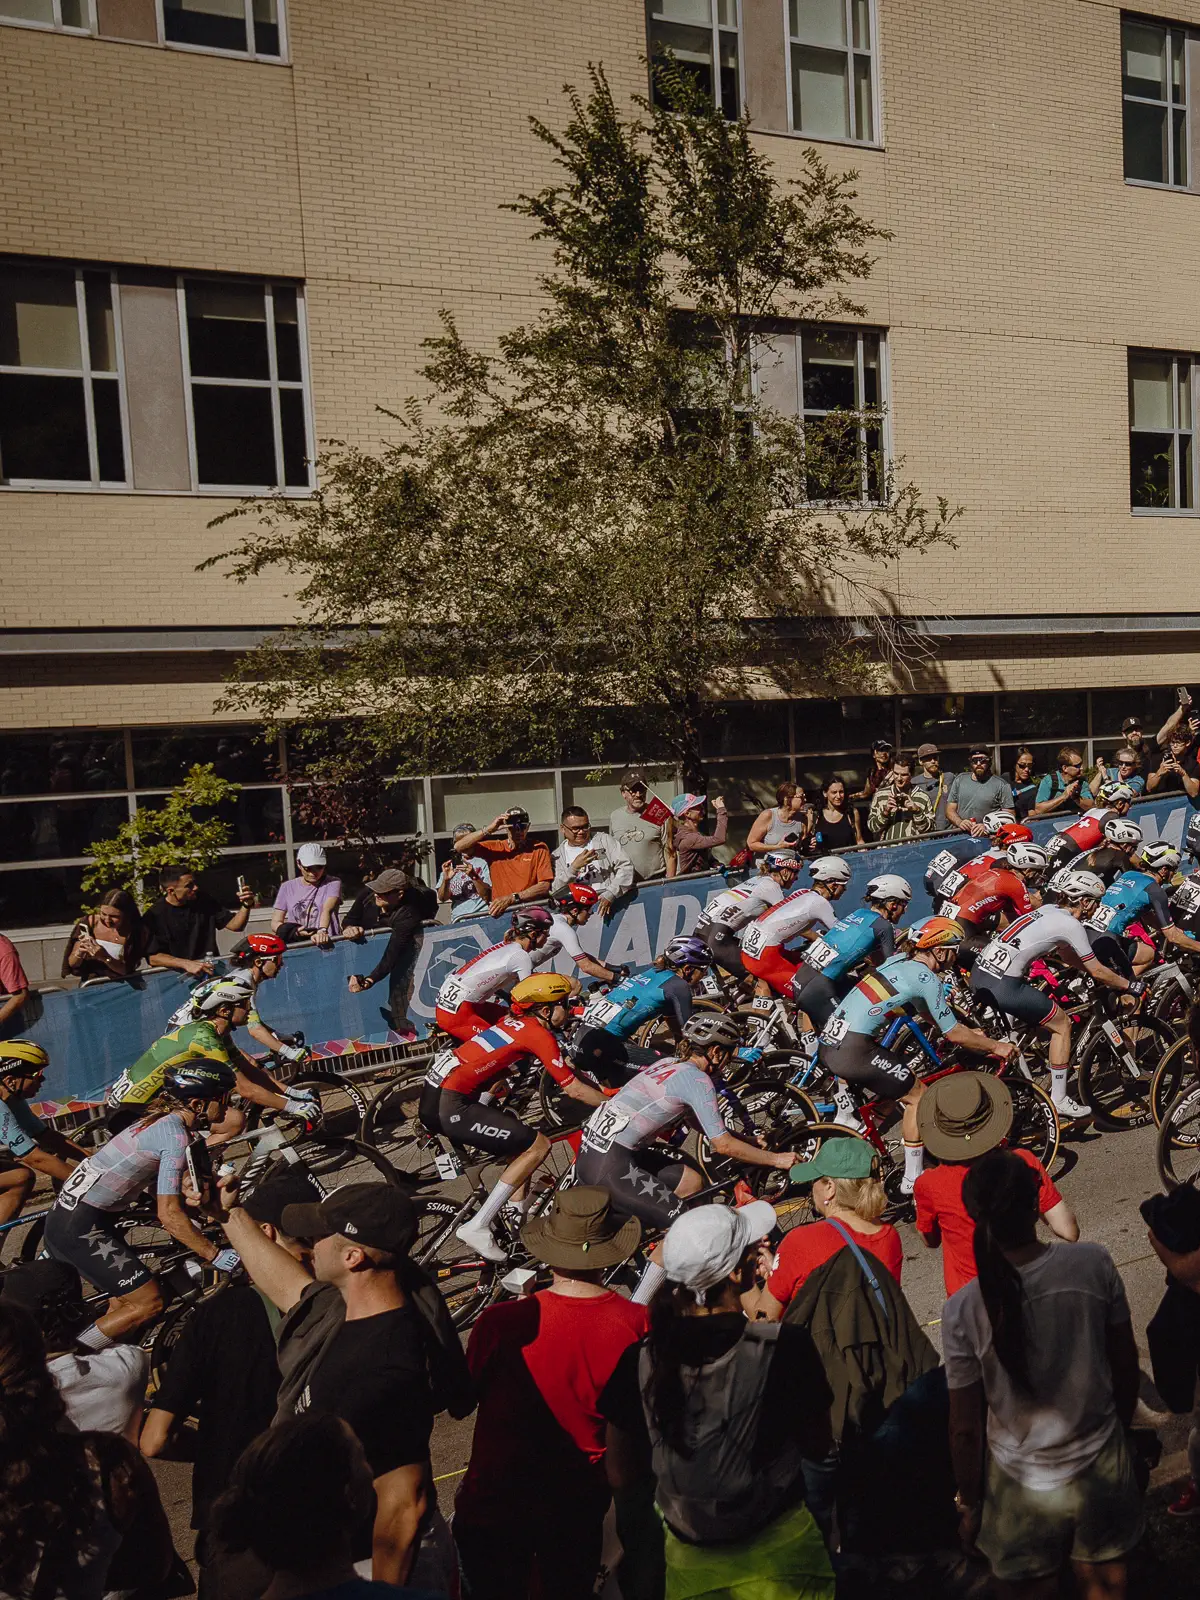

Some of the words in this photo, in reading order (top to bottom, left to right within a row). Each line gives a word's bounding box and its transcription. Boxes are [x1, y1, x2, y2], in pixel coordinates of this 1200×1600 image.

[1117, 832, 1127, 840] EF
[1017, 857, 1028, 866] EF
[1185, 887, 1200, 903] 32
[967, 895, 998, 914] FLOWEY
[720, 905, 742, 922] KTM
[1096, 908, 1111, 921] 15
[749, 931, 761, 945] 38
[989, 949, 1007, 966] 59
[444, 984, 461, 1002] 36
[597, 1001, 614, 1018] 21
[755, 999, 769, 1009] 38
[938, 1007, 951, 1020] AG
[175, 1066, 196, 1078] The
[837, 1095, 847, 1110] 53
[470, 1122, 511, 1141] NOR
[600, 1114, 617, 1136] 78
[8, 1133, 26, 1149] AG
[306, 1172, 328, 1199] CANYO
[117, 1269, 145, 1288] Rapha
